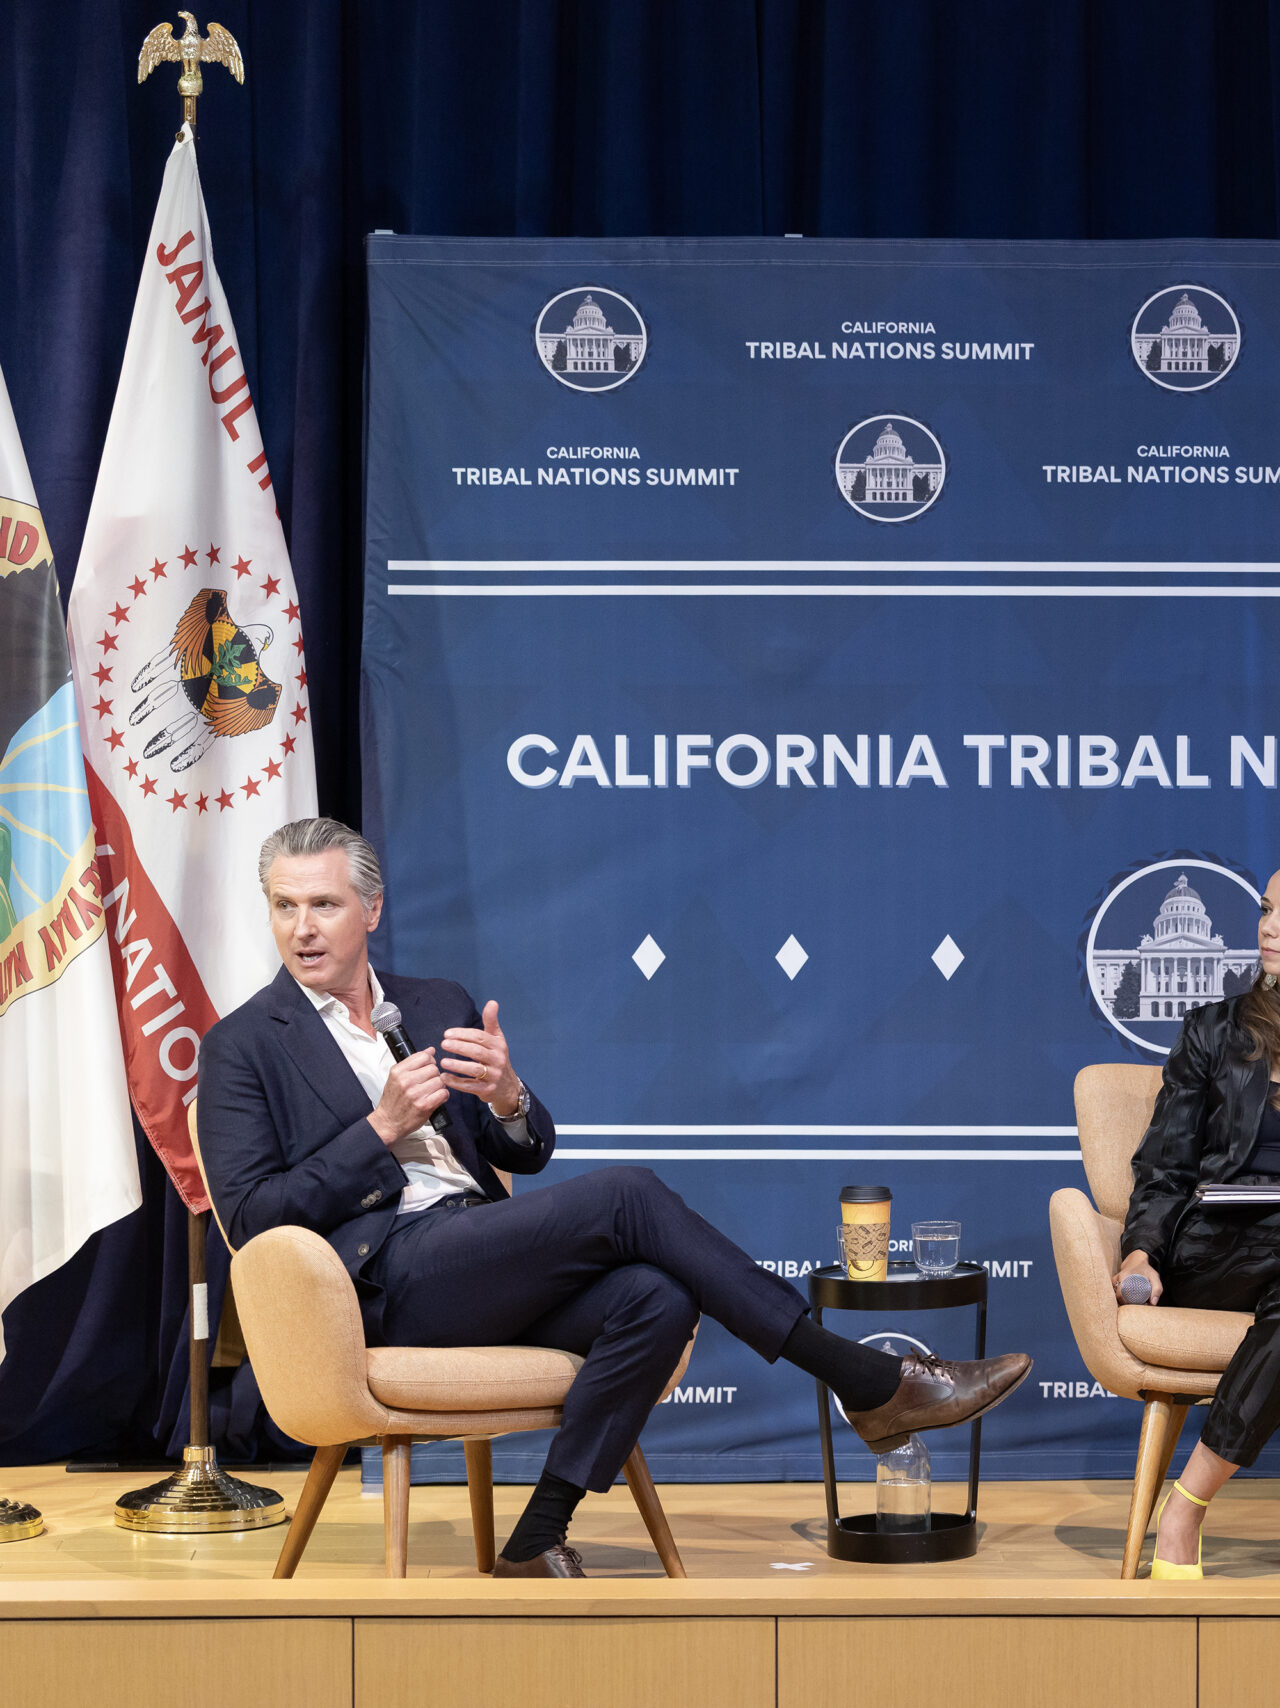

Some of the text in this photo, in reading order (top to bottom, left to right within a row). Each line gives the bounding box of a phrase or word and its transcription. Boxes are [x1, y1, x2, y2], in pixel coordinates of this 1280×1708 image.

[157, 230, 253, 442] JAMUL
[841, 321, 936, 334] CALIFORNIA
[745, 341, 1035, 361] TRIBAL NATIONS SUMMIT
[546, 446, 641, 460] CALIFORNIA
[1136, 445, 1230, 458] CALIFORNIA
[451, 467, 740, 486] TRIBAL NATIONS SUMMIT
[1042, 465, 1122, 483] TRIBAL
[1127, 465, 1230, 484] NATIONS
[506, 733, 949, 790] CALIFORNIA
[963, 734, 1211, 789] TRIBAL
[103, 876, 201, 1107] NATIO
